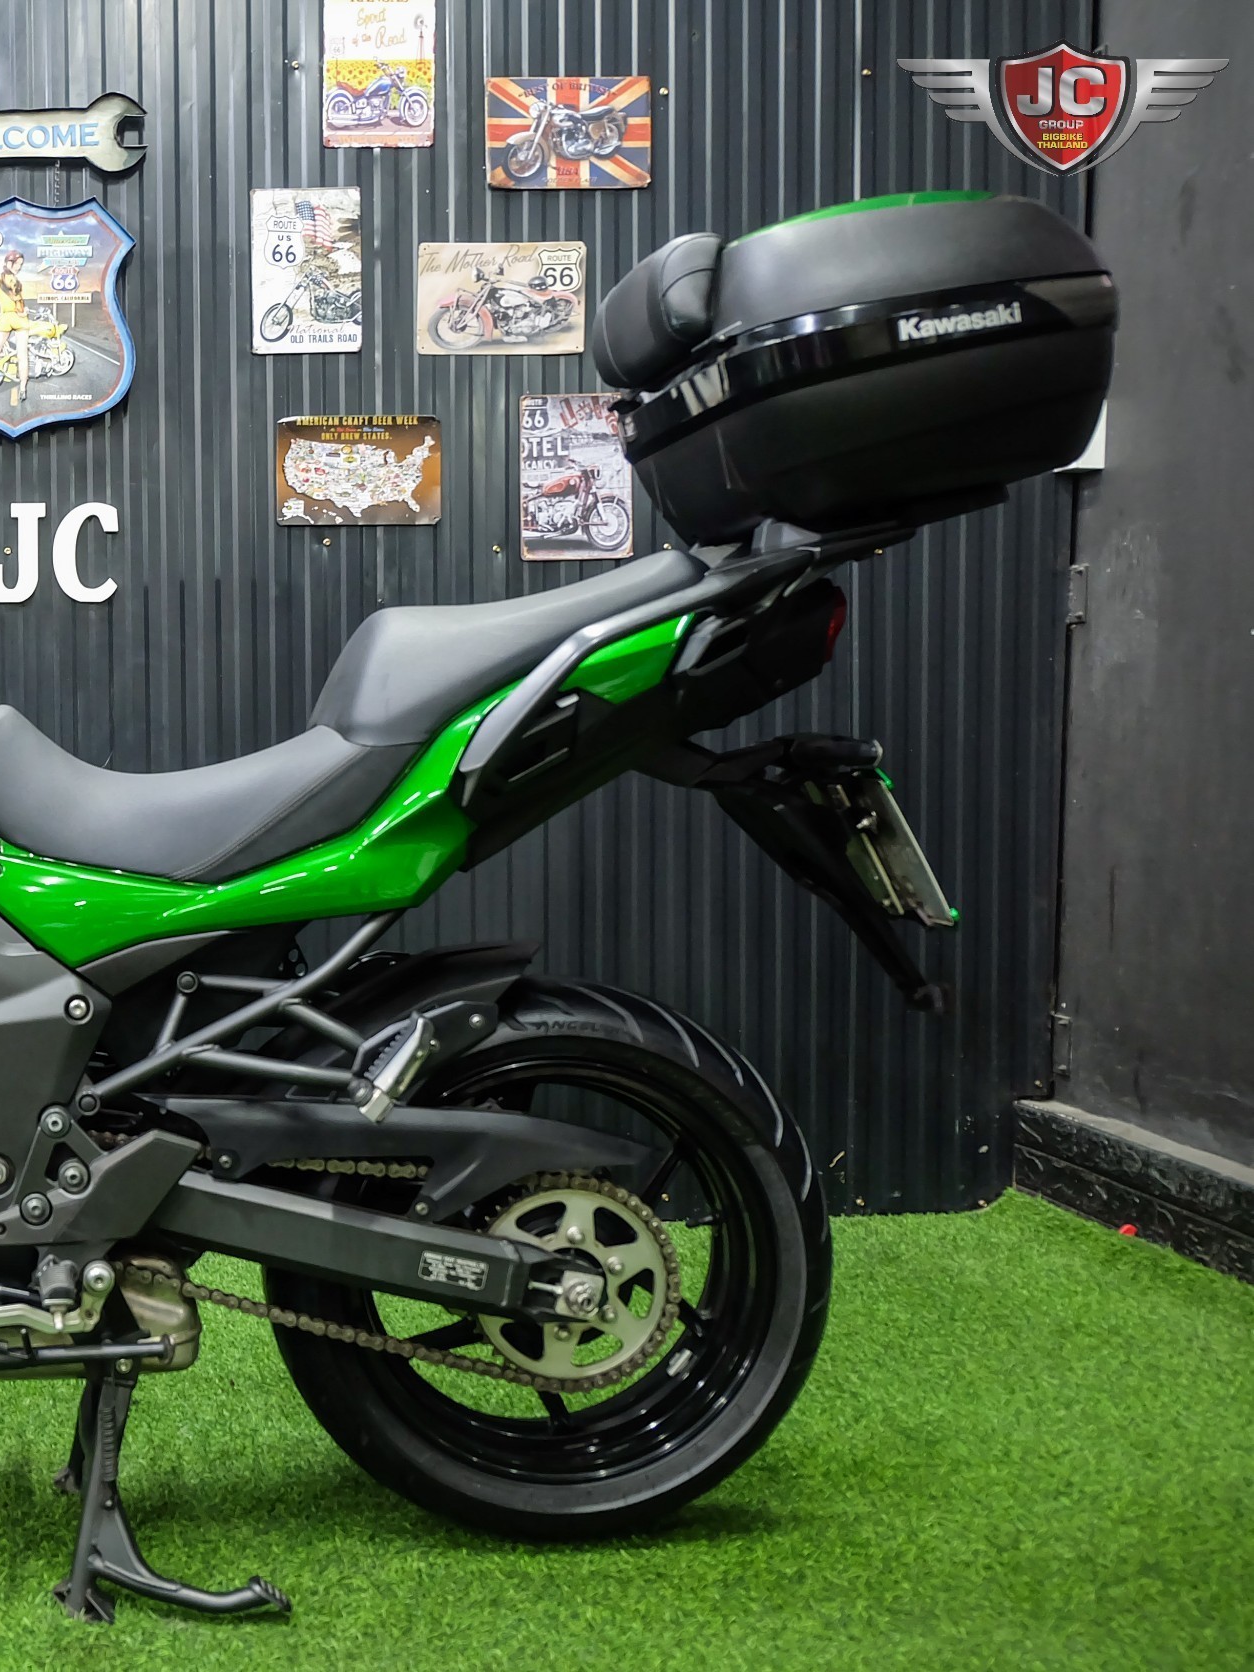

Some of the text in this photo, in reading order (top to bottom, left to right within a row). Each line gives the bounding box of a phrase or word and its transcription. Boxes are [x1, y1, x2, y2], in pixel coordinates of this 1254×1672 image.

[375, 26, 407, 49] Road
[273, 220, 297, 229] ROUTE
[272, 244, 297, 263] 66
[419, 244, 539, 276] The Mother Road
[52, 274, 76, 290] 66
[543, 266, 574, 287] 66
[288, 323, 346, 334] National
[897, 301, 1023, 342] Kawasaki
[290, 334, 358, 343] OLD TRAILS ROAD
[296, 415, 419, 426] AMERICAN CRAFT BEER WEEK
[522, 410, 545, 429] 66
[321, 432, 338, 440] ONLY
[340, 432, 360, 440] BREW
